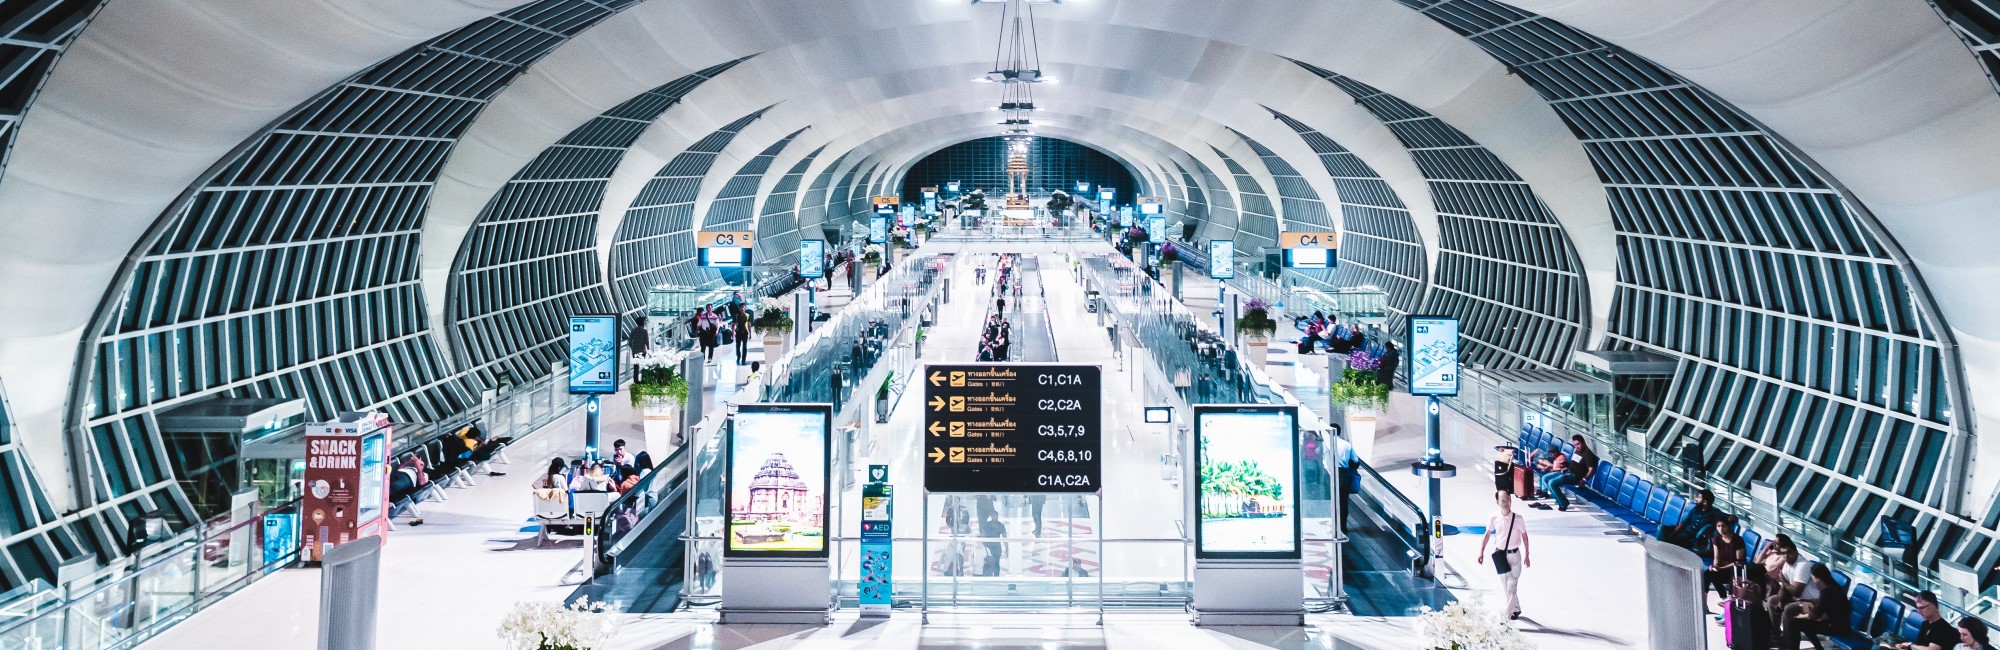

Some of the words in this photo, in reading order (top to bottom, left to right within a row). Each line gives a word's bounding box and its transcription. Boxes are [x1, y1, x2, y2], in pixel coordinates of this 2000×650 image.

[716, 233, 734, 245] C3
[1300, 234, 1319, 246] C4
[1038, 374, 1082, 386] C1,C1A
[1038, 399, 1082, 412] C2,C2A
[1038, 424, 1085, 438] C3,5,7,9
[310, 440, 356, 456] SNACK
[1038, 450, 1092, 462] C4,6,8,10
[1038, 475, 1090, 488] C1A,C2A
